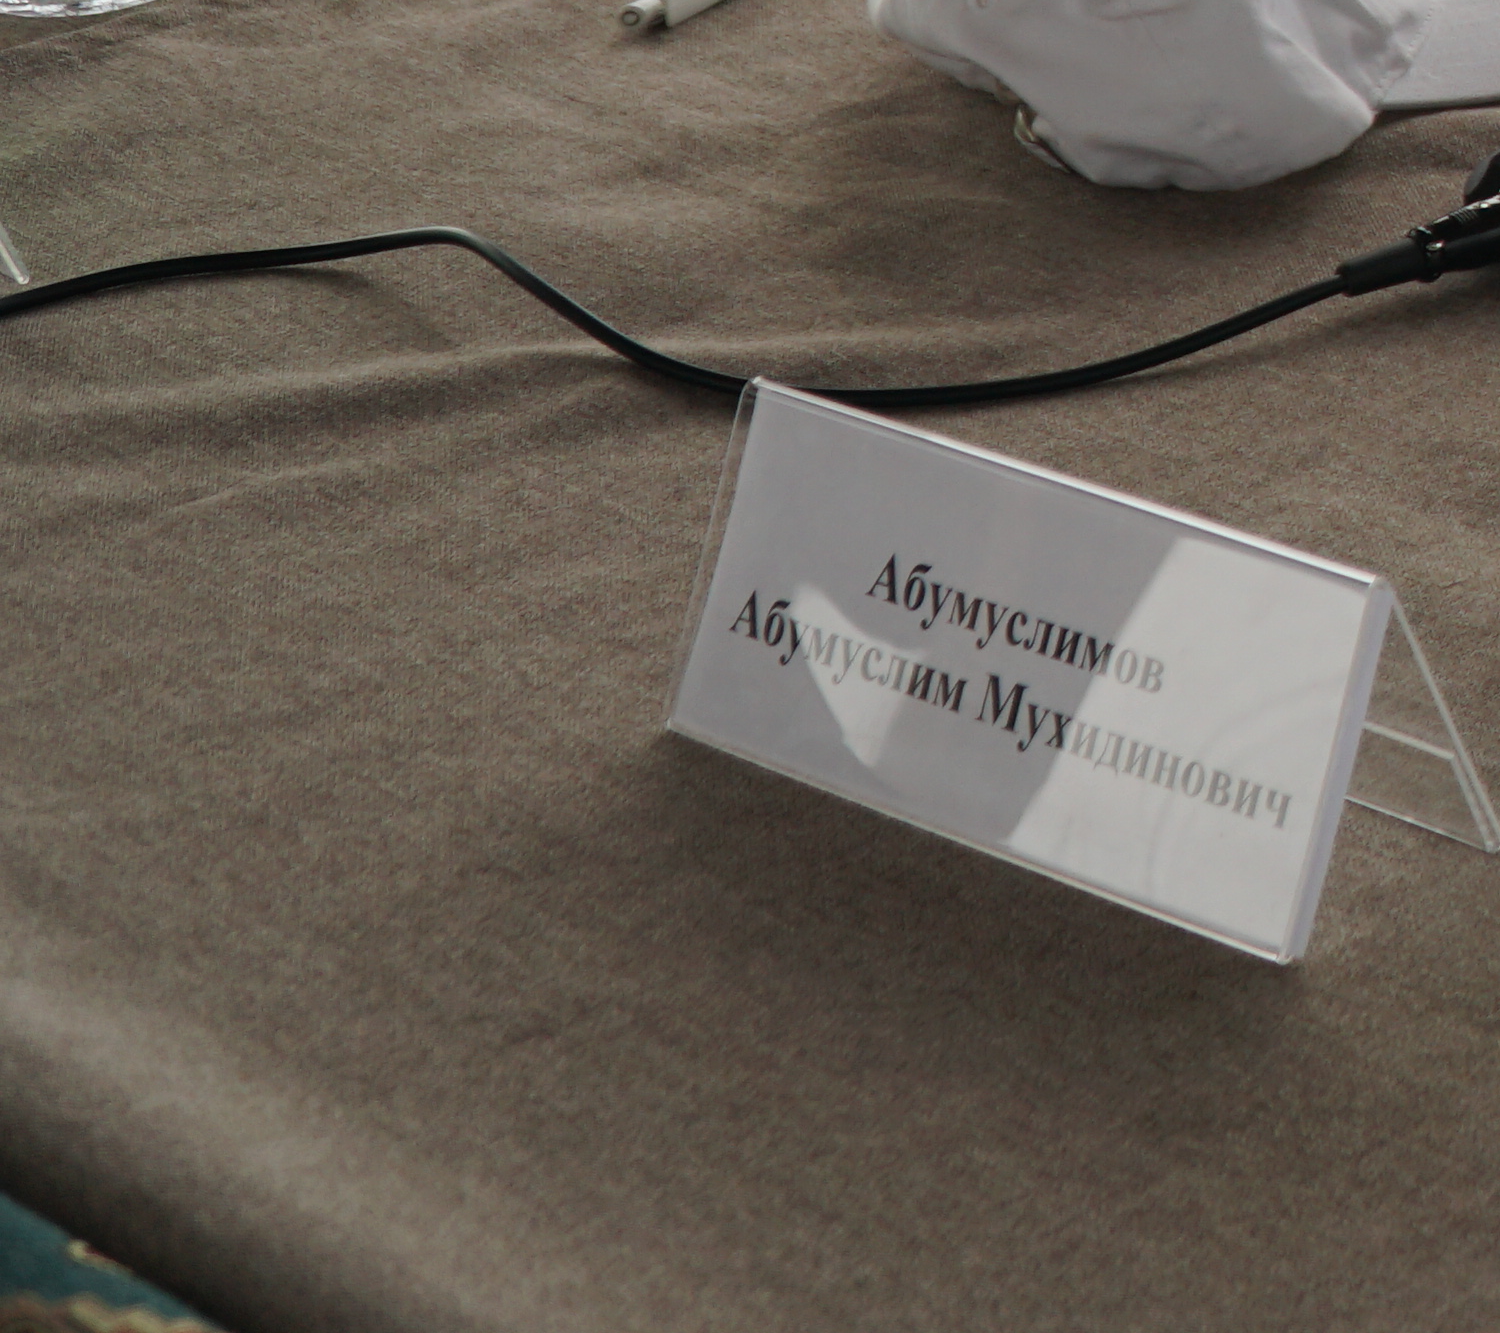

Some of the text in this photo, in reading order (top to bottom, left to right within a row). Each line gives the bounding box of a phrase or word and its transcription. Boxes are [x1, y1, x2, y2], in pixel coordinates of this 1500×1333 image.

[729, 588, 1294, 831] Абумуслим Мухидинович
[865, 551, 1167, 695] Абумуслимов
